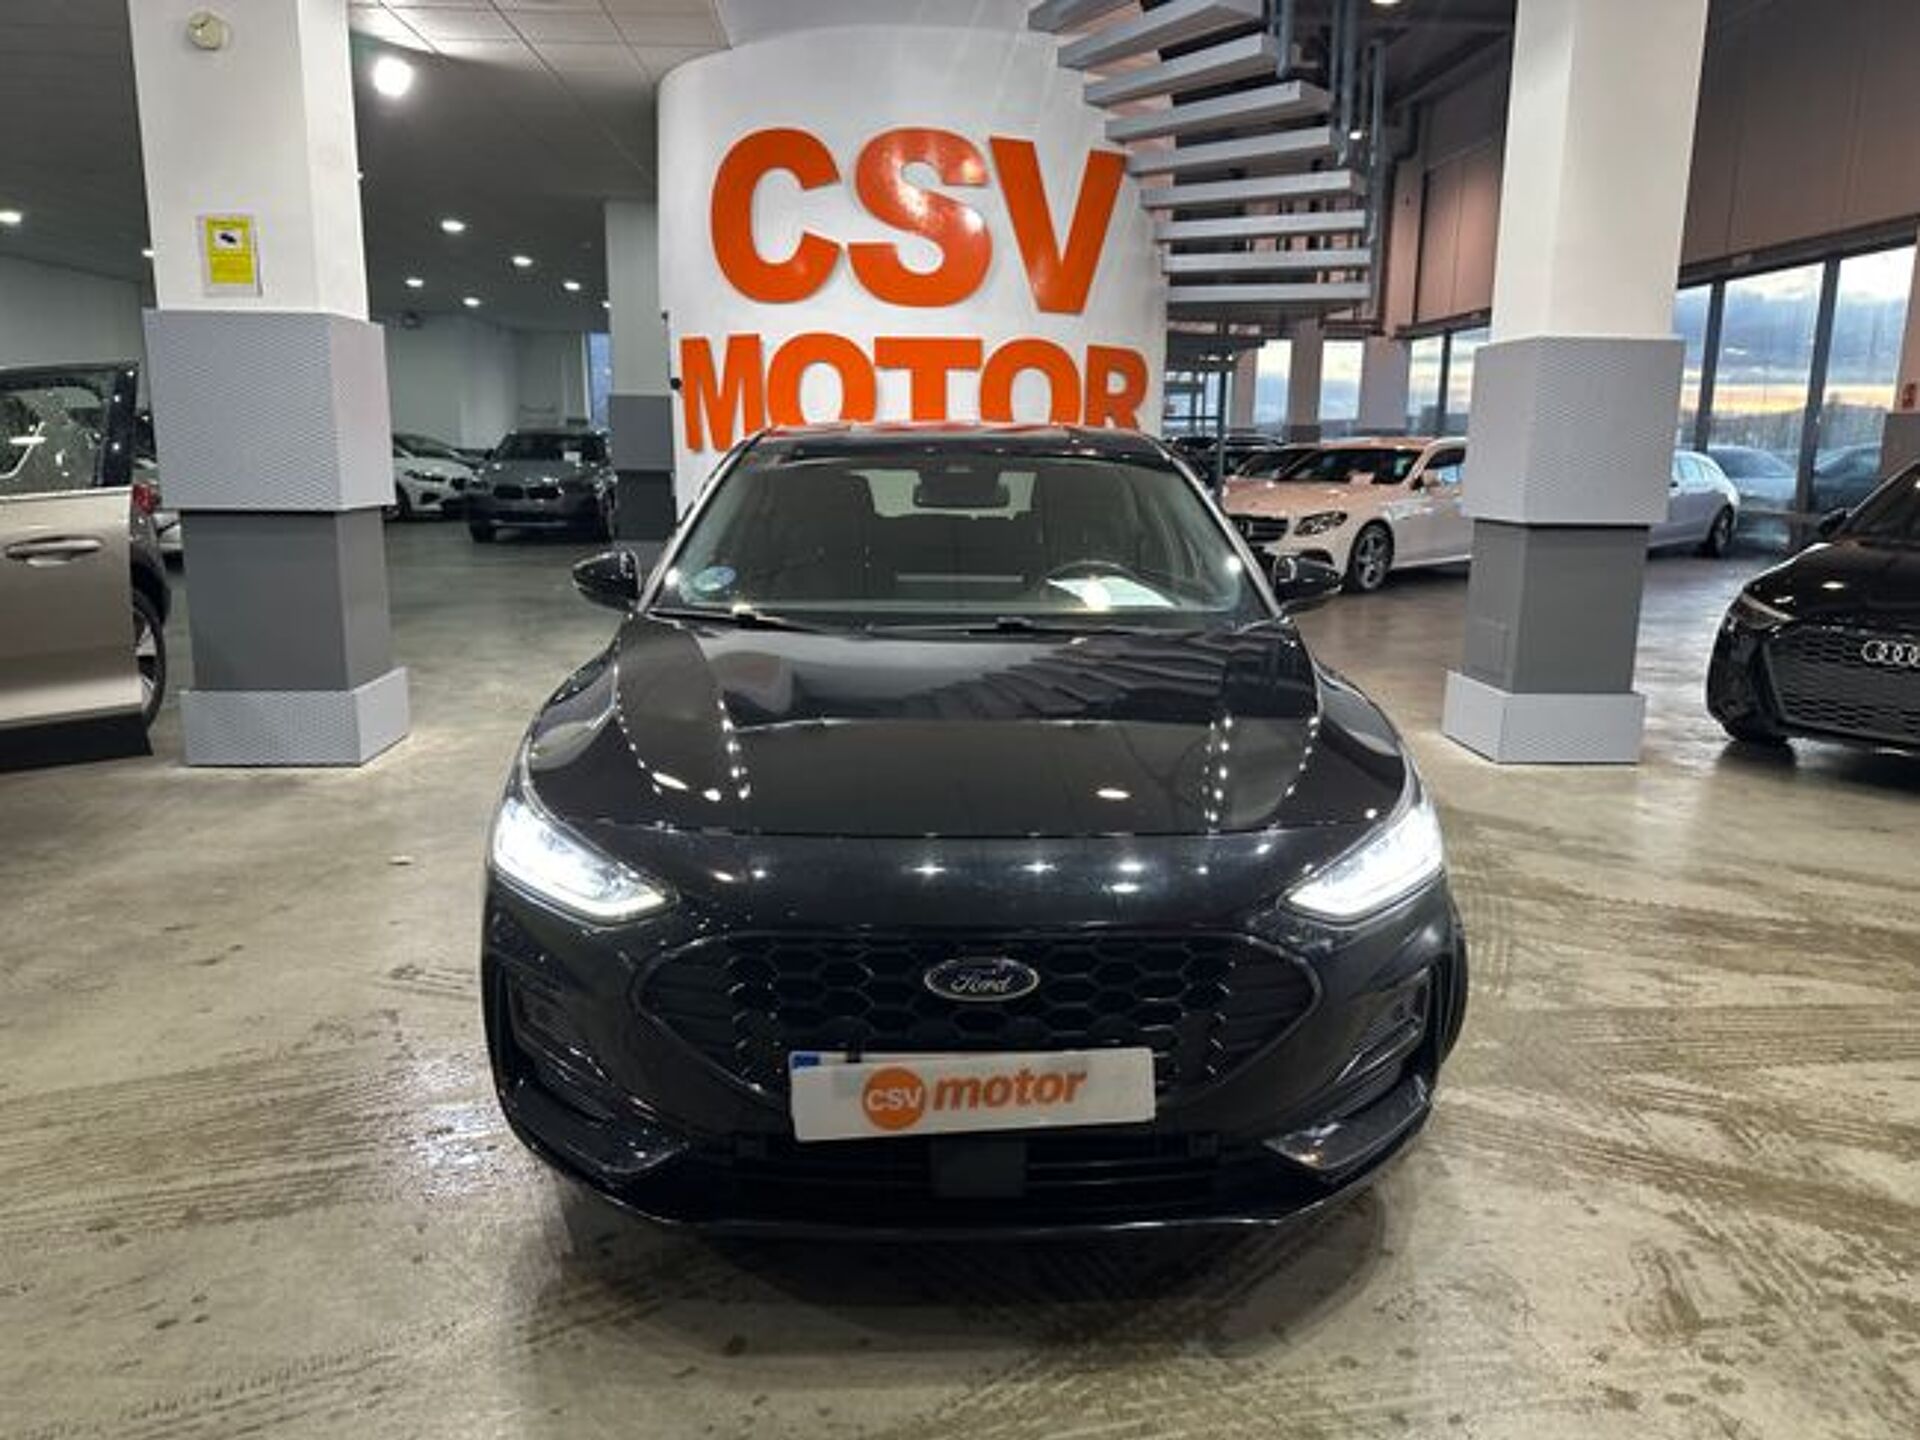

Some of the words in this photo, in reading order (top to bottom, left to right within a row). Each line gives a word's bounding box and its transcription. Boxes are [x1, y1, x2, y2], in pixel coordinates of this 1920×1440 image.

[710, 127, 1128, 314] CSV
[680, 332, 1150, 454] MOTOR
[950, 972, 1014, 993] Ford
[933, 1069, 1087, 1110] motor
